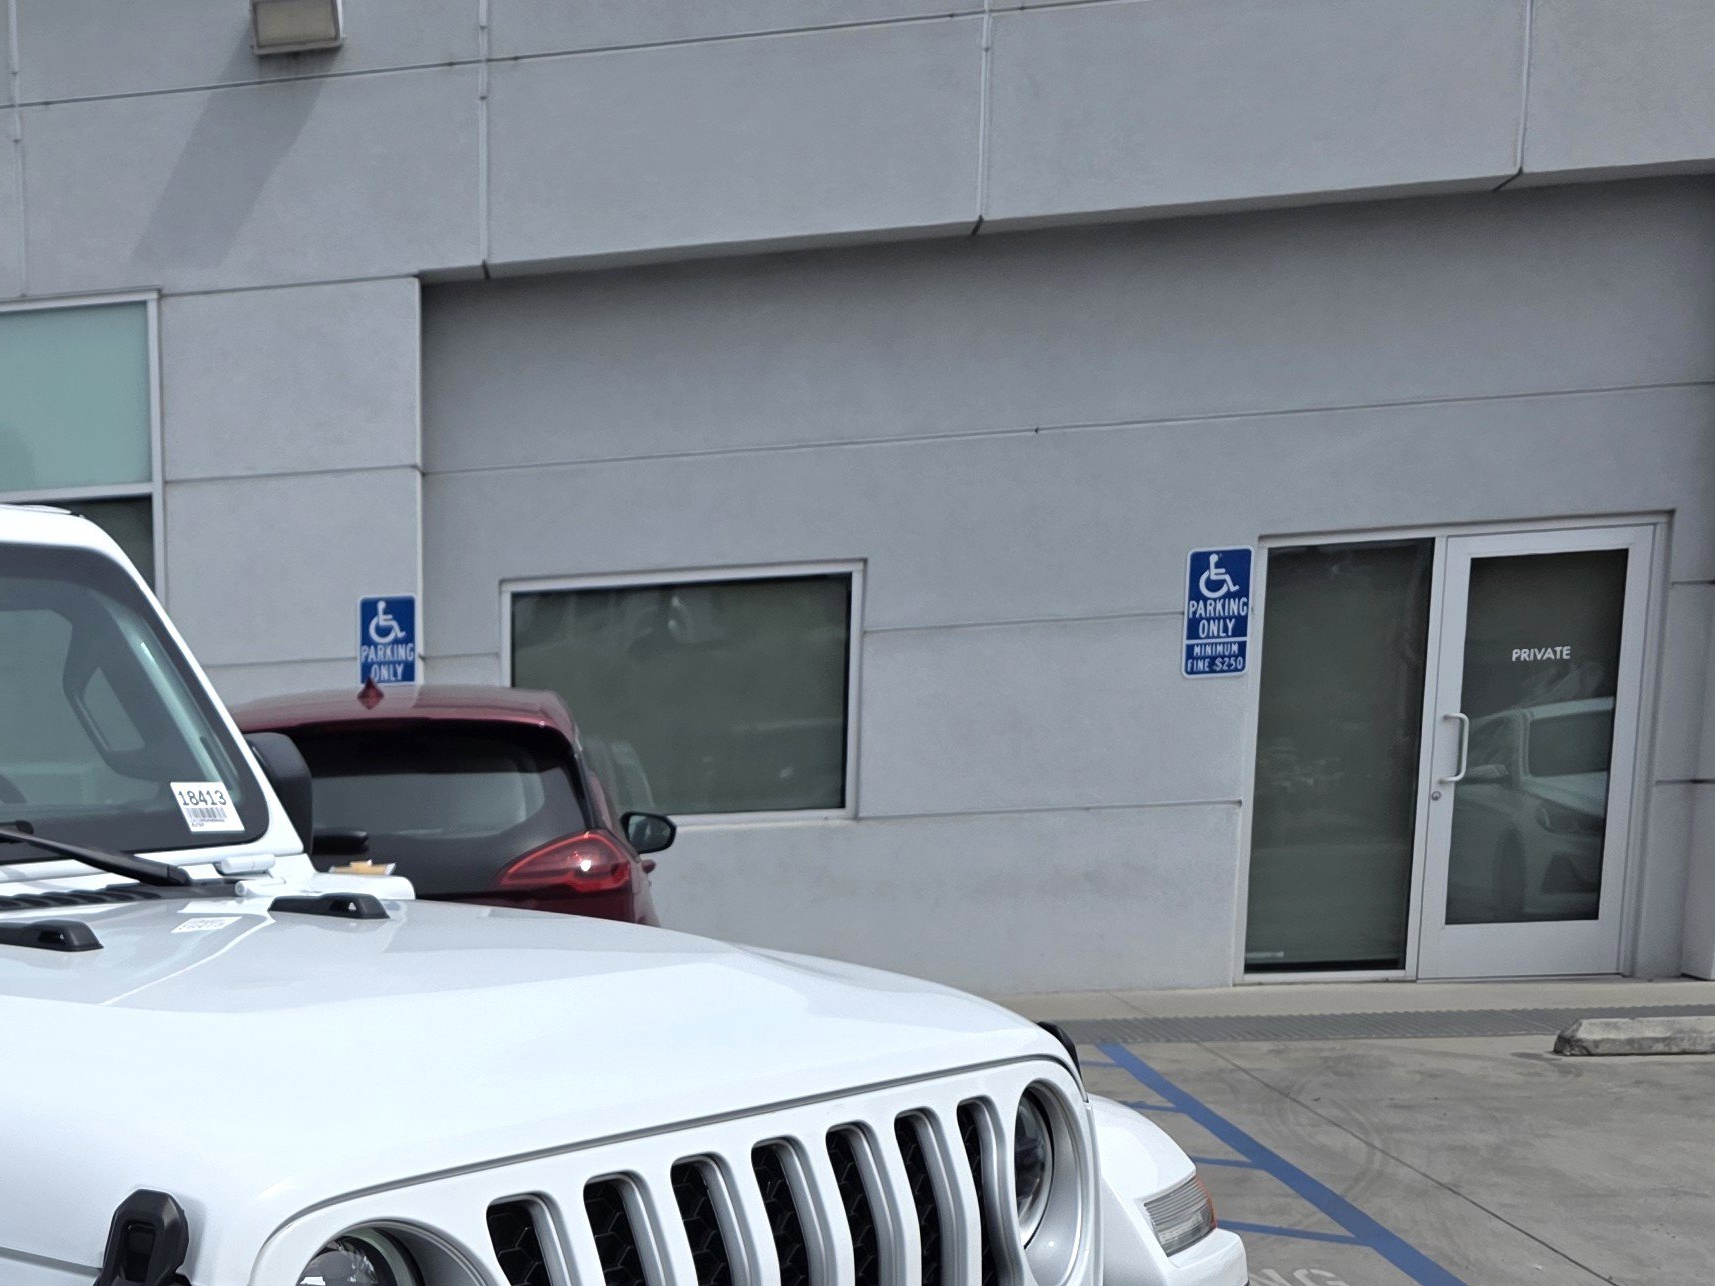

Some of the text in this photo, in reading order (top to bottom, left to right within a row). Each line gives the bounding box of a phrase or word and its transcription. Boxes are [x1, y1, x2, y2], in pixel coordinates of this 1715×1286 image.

[1189, 597, 1247, 618] PARKING
[1199, 618, 1235, 638] ONLY
[361, 643, 414, 662] PARKING
[1193, 642, 1238, 657] MINIMUM
[1512, 645, 1571, 661] PRIVATE
[371, 663, 403, 681] ONLY
[1187, 656, 1243, 672] FINE $250
[178, 789, 226, 806] 18413
